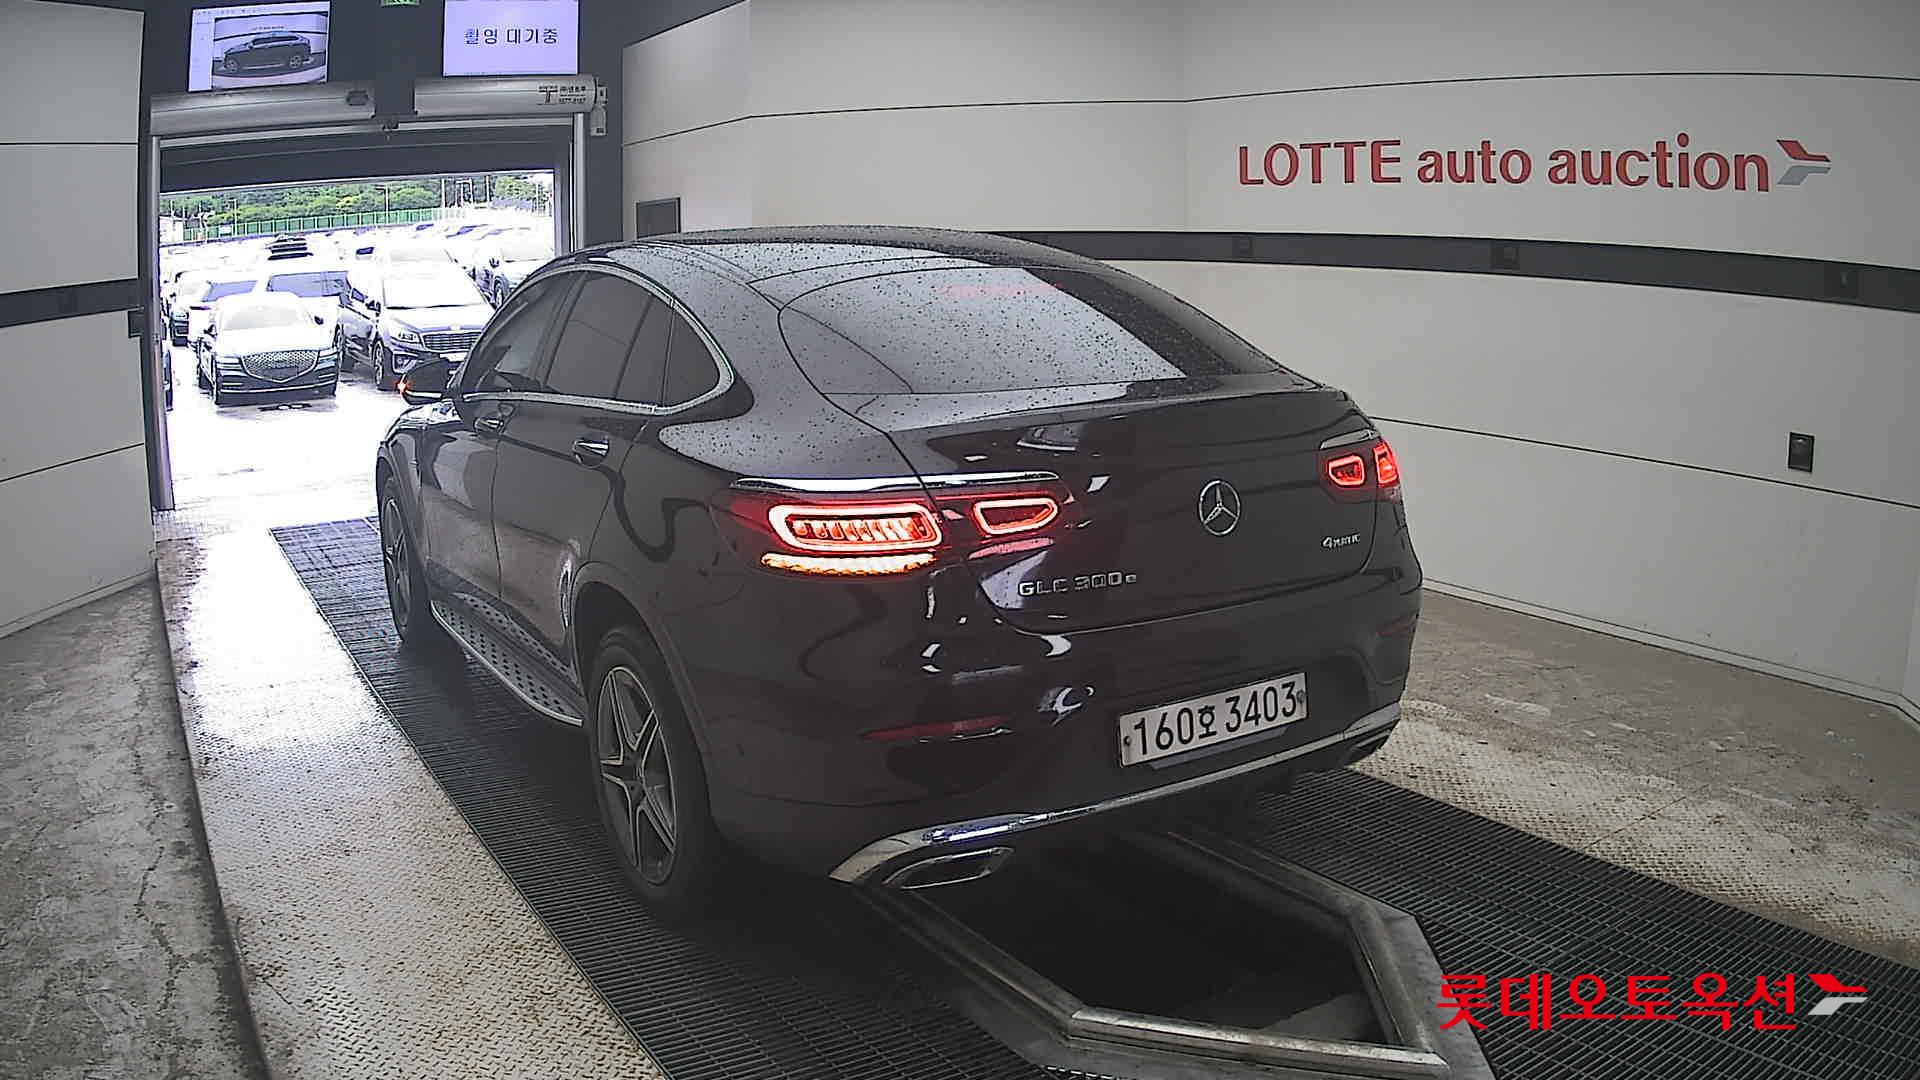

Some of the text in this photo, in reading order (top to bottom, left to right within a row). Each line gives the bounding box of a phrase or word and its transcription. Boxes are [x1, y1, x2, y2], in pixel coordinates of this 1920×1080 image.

[507, 28, 558, 44] 대기중
[1239, 133, 1770, 192] LOTTE auto auction
[1019, 578, 1068, 596] GLC
[1134, 681, 1297, 756] 160호 3403
